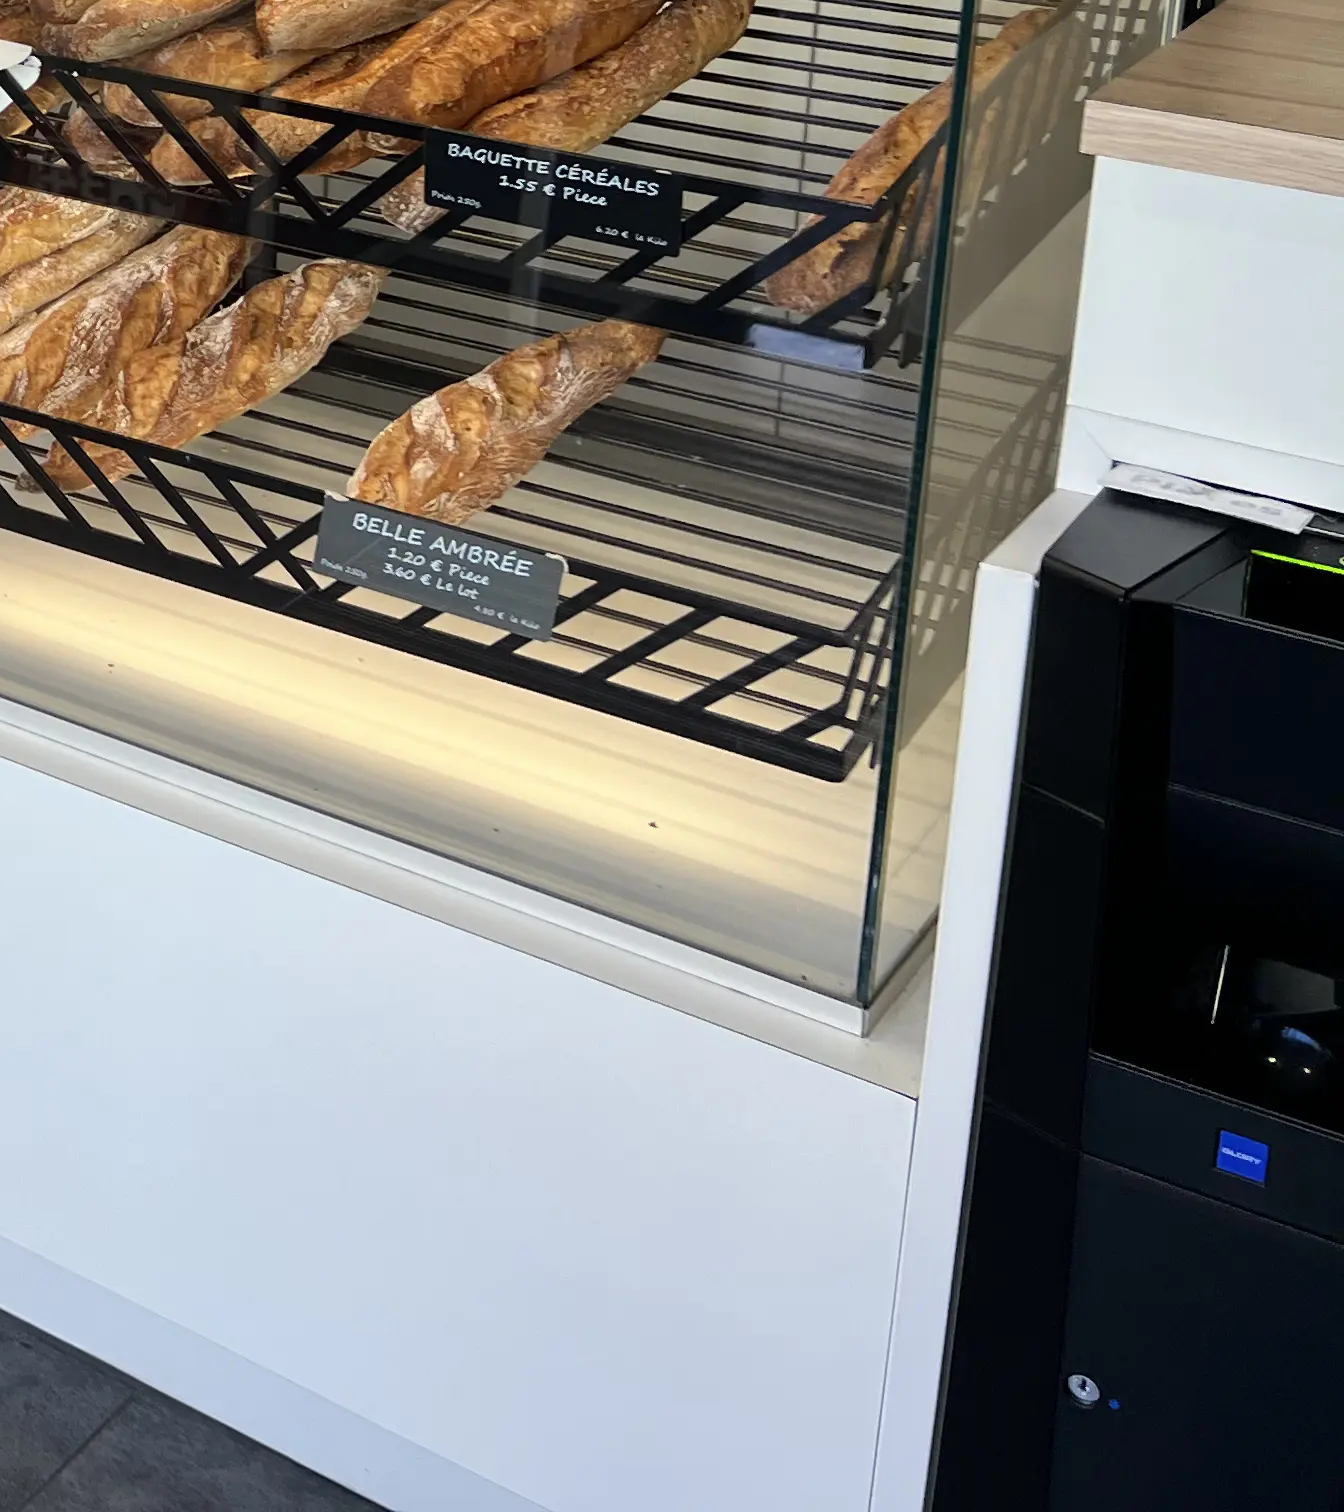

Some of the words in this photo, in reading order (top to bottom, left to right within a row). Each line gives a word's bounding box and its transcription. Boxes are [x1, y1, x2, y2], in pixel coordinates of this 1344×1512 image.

[447, 143, 550, 175] BAGUETTE
[555, 163, 660, 197] CÉRÉALES
[498, 175, 539, 193] 1.55
[542, 183, 556, 197] €
[352, 512, 426, 546] BELLE
[429, 535, 533, 578] AMBRÉE
[388, 547, 426, 566] 1.20
[430, 559, 443, 572] €
